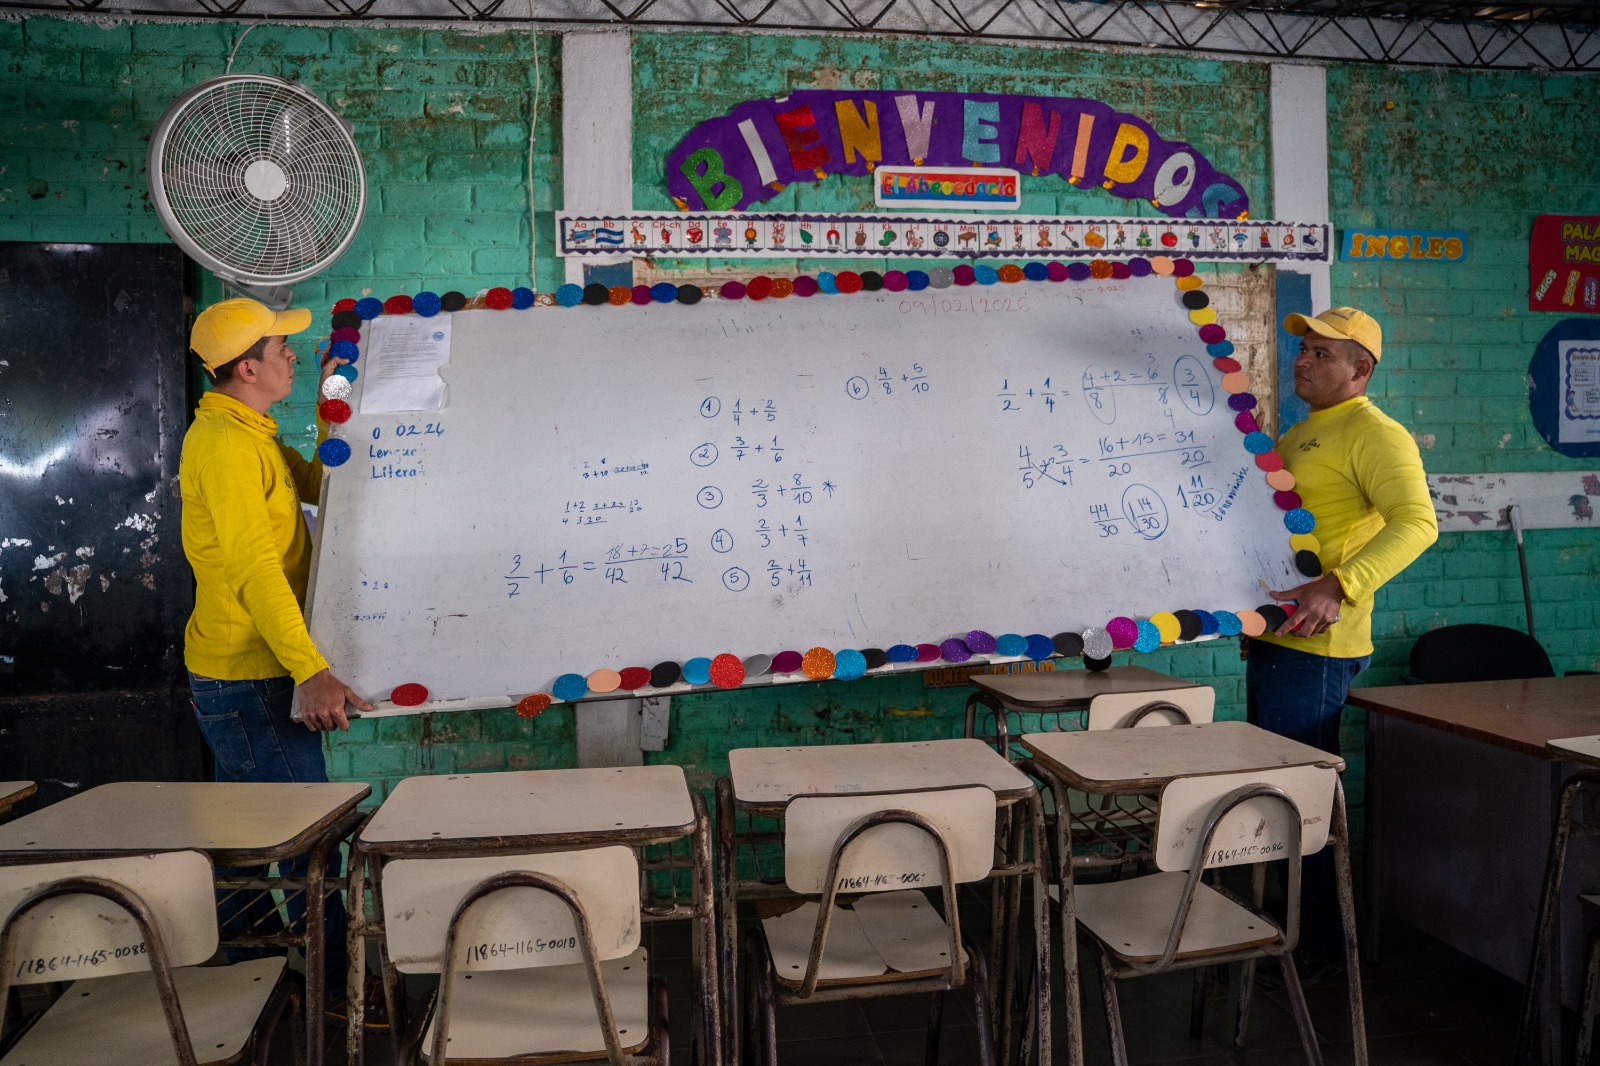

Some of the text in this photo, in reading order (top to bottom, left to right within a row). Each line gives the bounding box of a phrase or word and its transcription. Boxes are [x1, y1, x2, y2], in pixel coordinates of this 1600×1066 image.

[680, 95, 1242, 218] BIENVENIDOS
[882, 174, 1015, 197] El Abecedario
[1349, 233, 1463, 259] INGLES
[879, 366, 887, 378] 4
[914, 363, 923, 373] 5
[1083, 374, 1094, 388] 4
[1114, 371, 1126, 382] 2
[1184, 369, 1195, 382] 3
[883, 382, 892, 394] 8
[912, 382, 929, 393] 10
[1003, 379, 1007, 390] 1
[1044, 377, 1050, 388] 1
[735, 398, 740, 410] 1
[766, 400, 775, 409] 2
[1003, 400, 1020, 410] 2
[1046, 397, 1055, 413] 4
[1090, 392, 1102, 409] 8
[1190, 391, 1200, 407] 4
[734, 414, 740, 425] 4
[767, 413, 775, 421] 5
[736, 437, 745, 445] 3
[772, 435, 777, 446] 1
[1132, 432, 1153, 445] 15
[1174, 431, 1195, 443] 31
[1053, 444, 1068, 456] 3
[1099, 437, 1113, 454] 16
[737, 450, 745, 461] 7
[774, 452, 782, 462] 6
[1019, 446, 1031, 468] 4
[1182, 450, 1204, 462] 20
[1109, 462, 1131, 476] 20
[792, 473, 802, 485] 8
[1023, 472, 1034, 488] 5
[1063, 466, 1073, 486] 4
[752, 479, 769, 488] 2
[793, 491, 812, 504] 10
[1177, 475, 1214, 508] 1 11 20
[757, 494, 767, 507] 3
[1138, 497, 1152, 511] 14
[759, 519, 769, 529] 2
[796, 515, 801, 526] 1
[1089, 503, 1119, 538] 44 30
[1142, 516, 1160, 530] 30
[760, 534, 771, 547] 3
[797, 534, 808, 546] 7
[510, 554, 521, 575] 3
[560, 549, 566, 563] 1
[563, 570, 574, 584] 6
[605, 567, 628, 584] 42
[661, 562, 693, 584] 42
[768, 559, 779, 567] 2
[798, 558, 806, 569] 4
[771, 571, 780, 586] 5
[800, 573, 811, 586] 11
